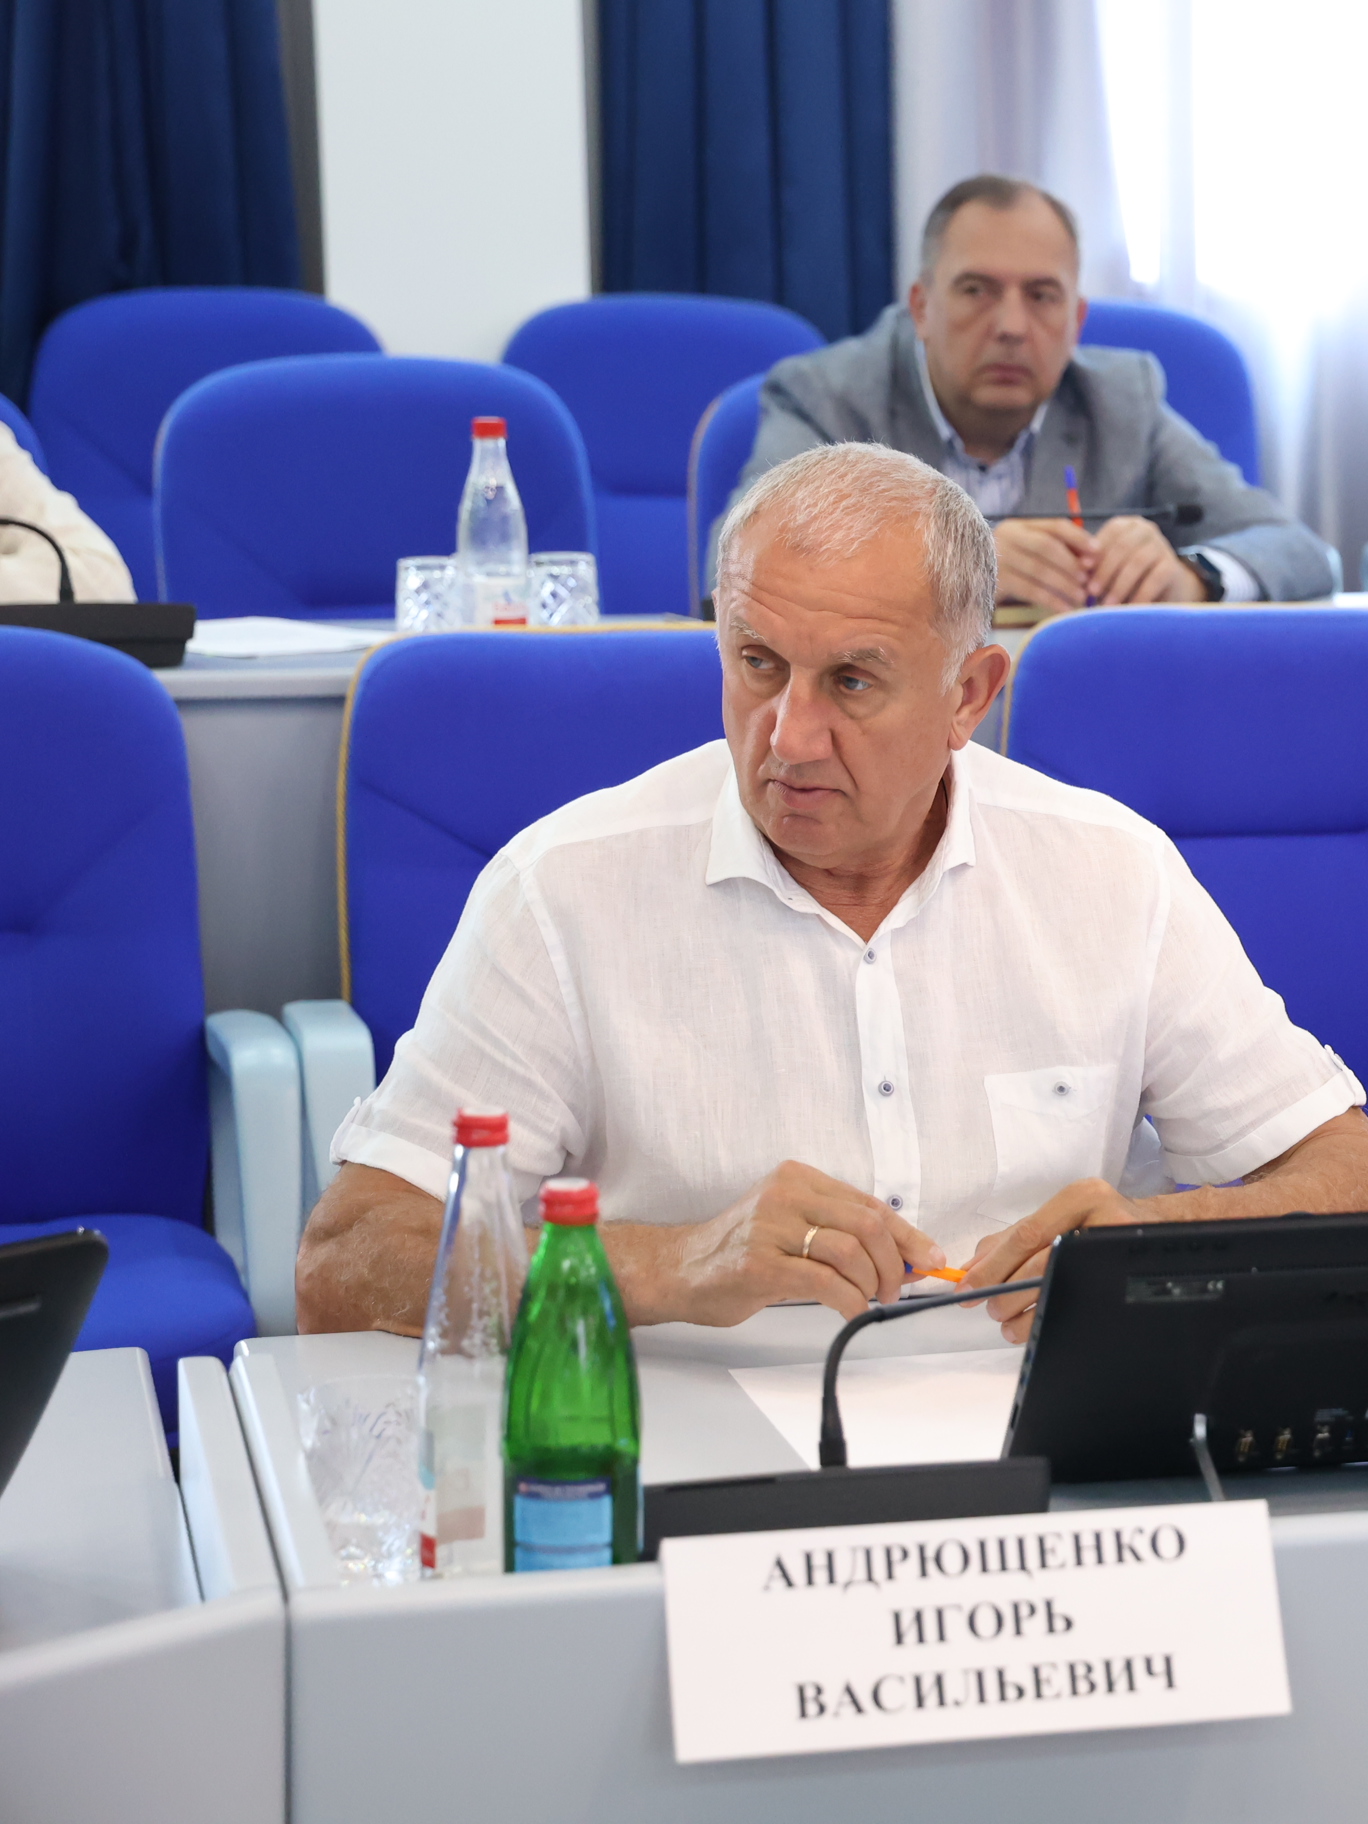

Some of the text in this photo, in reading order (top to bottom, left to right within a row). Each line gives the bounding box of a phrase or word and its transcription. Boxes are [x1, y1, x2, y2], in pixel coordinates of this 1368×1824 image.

[762, 1524, 1188, 1594] АНДРЮЩЕНКО
[891, 1598, 1075, 1647] ИГОРЬ
[795, 1653, 1178, 1720] ВАСИЛЬЕВИЧ
